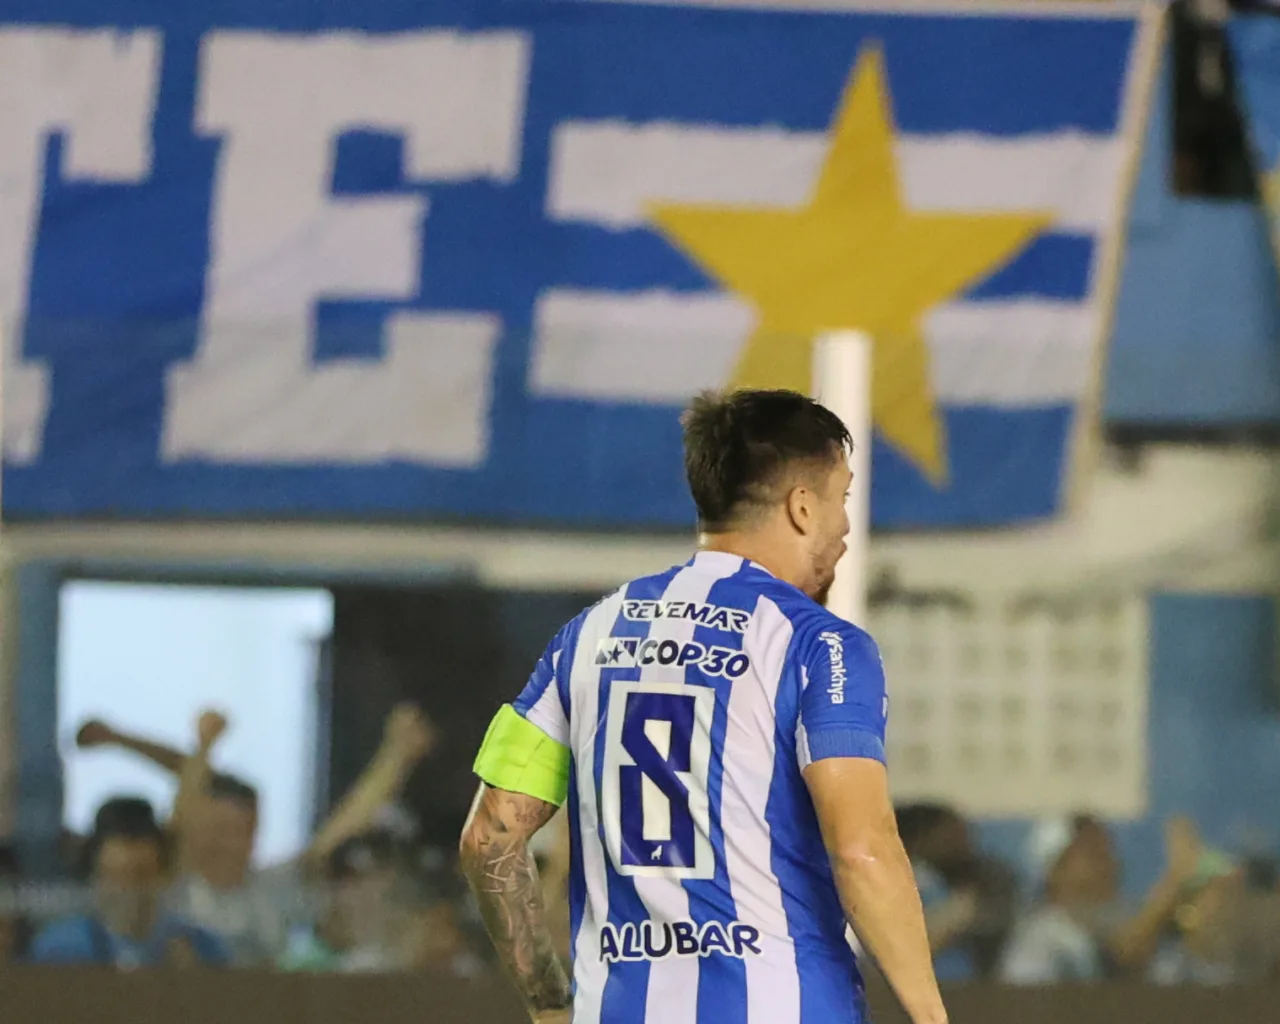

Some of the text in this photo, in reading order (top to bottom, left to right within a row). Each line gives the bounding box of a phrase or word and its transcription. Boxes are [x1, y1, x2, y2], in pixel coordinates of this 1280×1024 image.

[622, 600, 750, 633] REVEMAR
[618, 690, 698, 870] 8
[599, 920, 762, 962] ALUBAR
